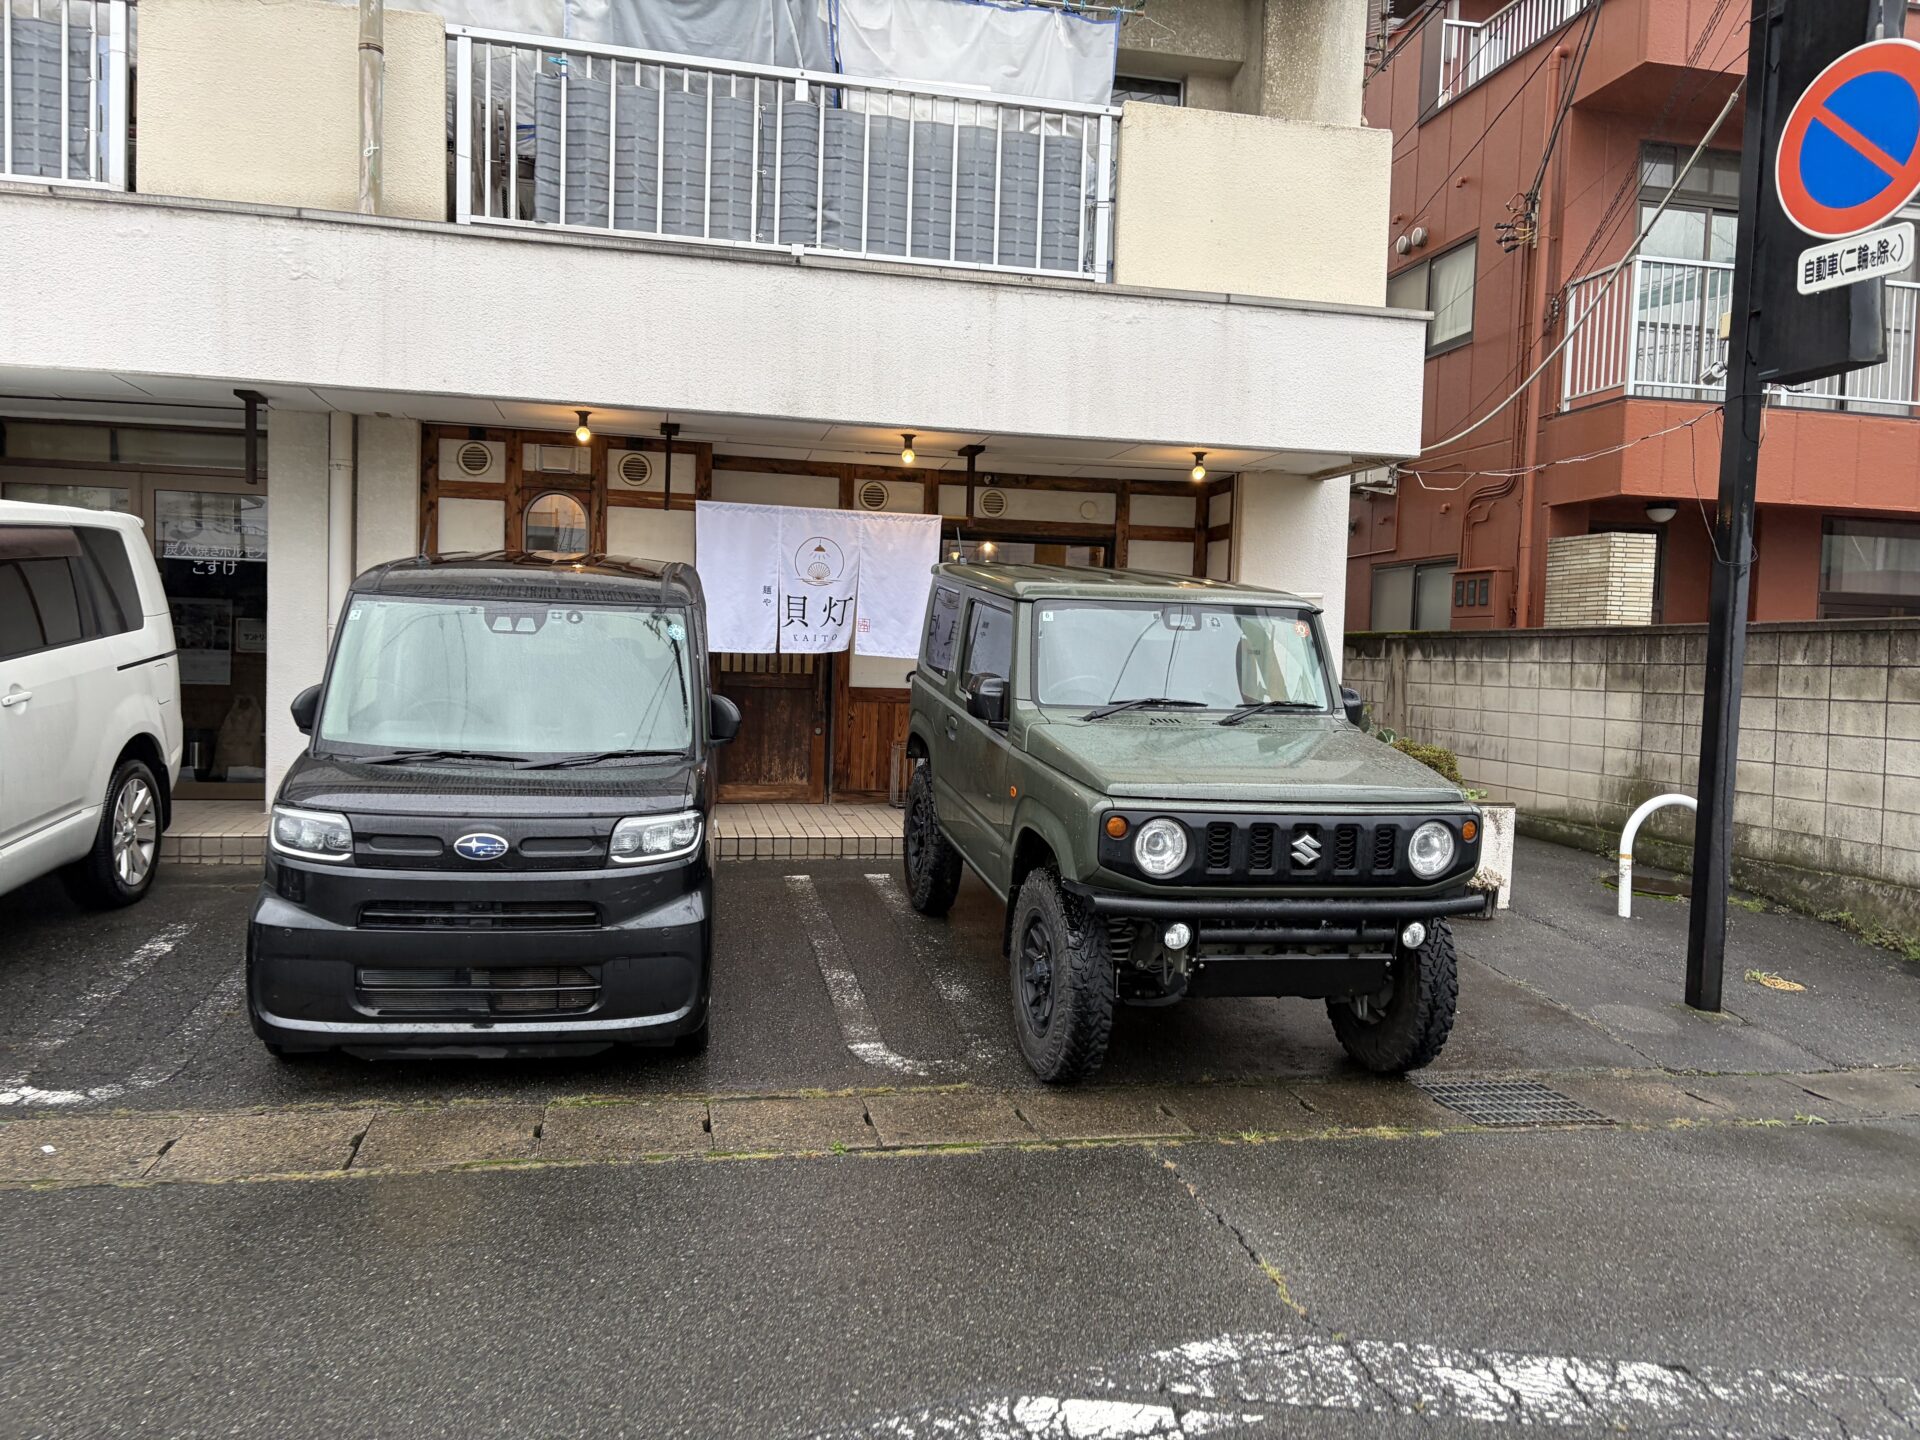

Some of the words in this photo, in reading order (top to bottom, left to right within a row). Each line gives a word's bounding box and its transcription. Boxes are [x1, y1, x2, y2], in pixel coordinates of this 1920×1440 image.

[1804, 234, 1904, 285] 自動車(二輪を除く)
[164, 542, 265, 558] 炭火焼きホルモン
[192, 560, 238, 576] こすけ
[782, 594, 854, 628] 貝灯
[793, 634, 838, 642] KAITO
